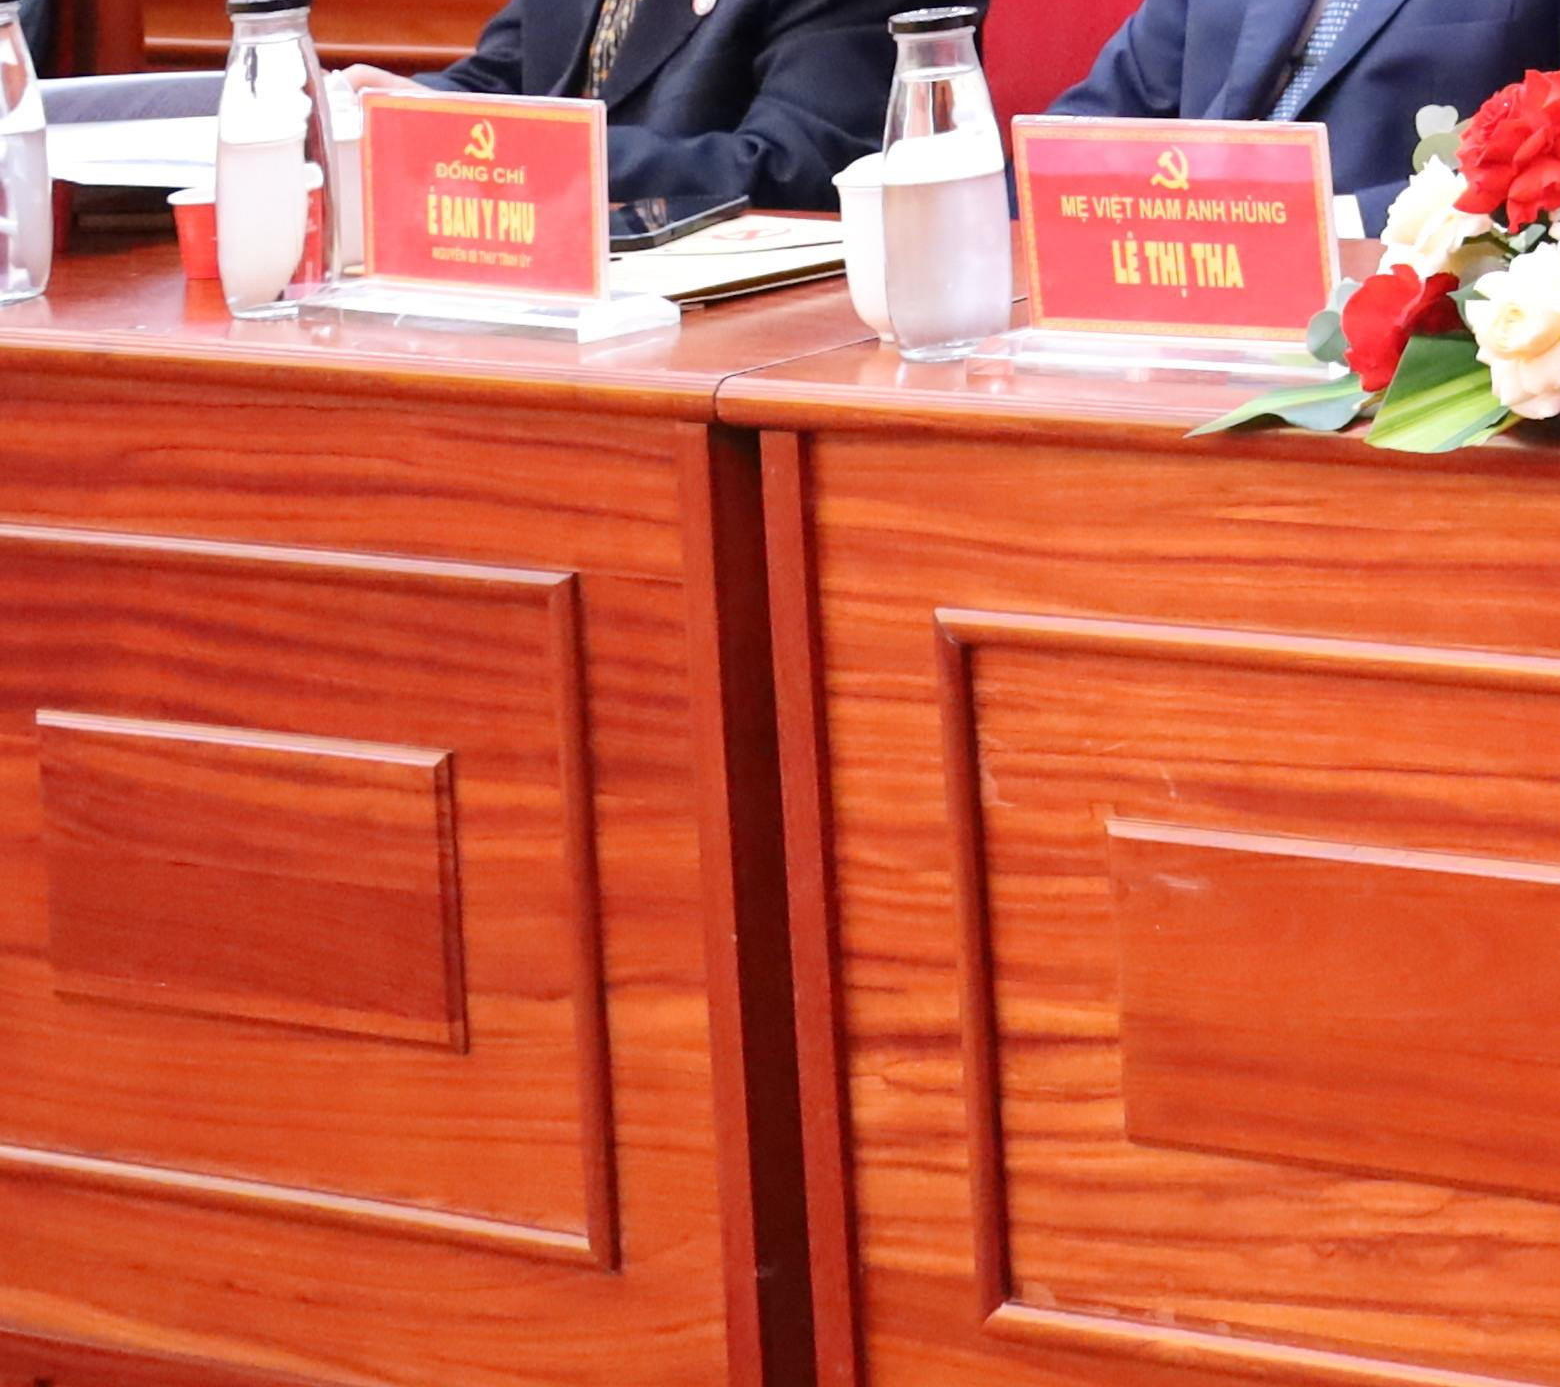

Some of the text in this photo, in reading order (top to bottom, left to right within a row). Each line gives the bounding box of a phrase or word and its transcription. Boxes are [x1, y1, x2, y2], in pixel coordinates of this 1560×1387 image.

[493, 166, 524, 184] CHÍ
[441, 195, 479, 239] BAN
[481, 198, 493, 240] Y
[498, 200, 535, 245] PHU
[1061, 194, 1287, 224] MẸ VIỆT NAM ANH HÙNG
[1144, 241, 1188, 298] THỊ
[1191, 243, 1245, 288] THA
